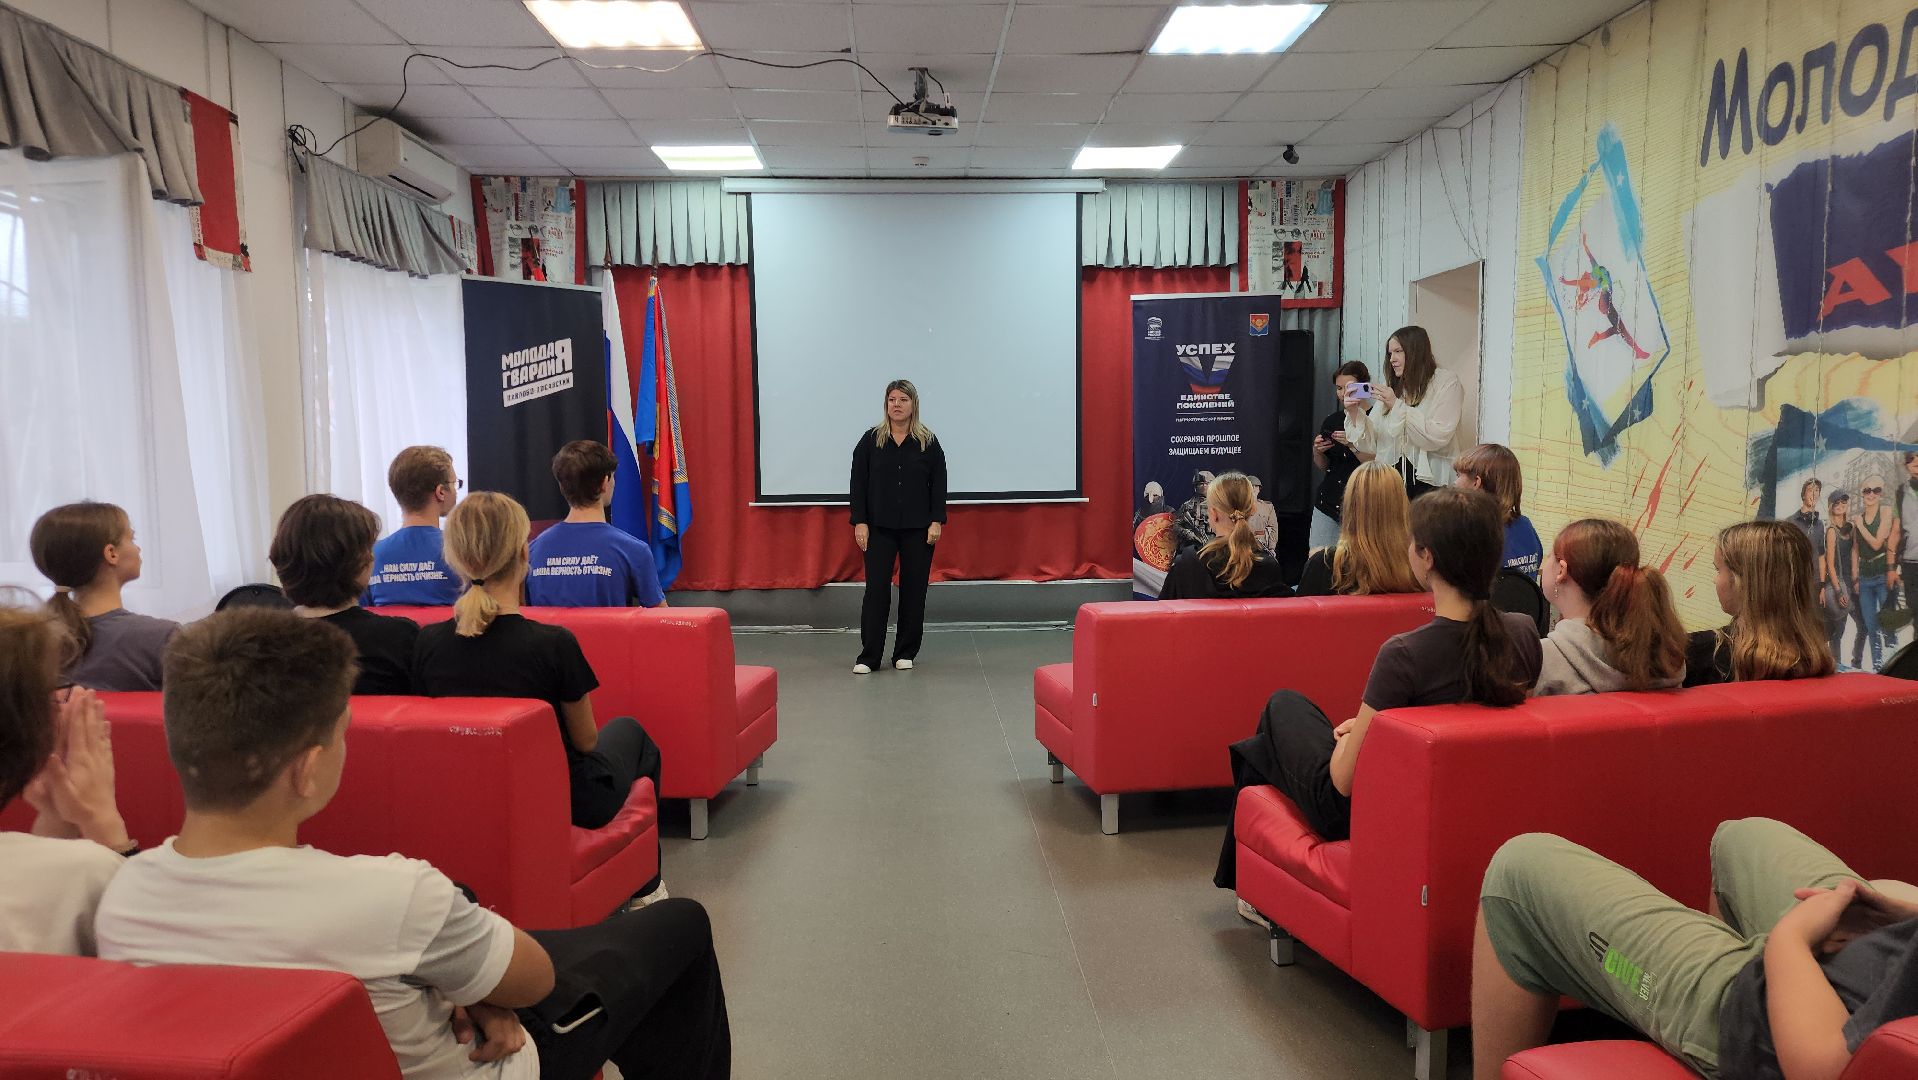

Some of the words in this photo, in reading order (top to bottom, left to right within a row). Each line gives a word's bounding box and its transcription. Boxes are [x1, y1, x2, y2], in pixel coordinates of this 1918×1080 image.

[1176, 343, 1235, 355] УСПЕХ
[1180, 393, 1231, 401] ЕДИНСТВЕ
[1176, 400, 1235, 409] ПОКОЛЕНИЙ
[1170, 435, 1205, 444] СОХРАНЯЯ
[1206, 434, 1240, 443] ПРОШЛОЕ
[1168, 447, 1209, 456] ЗАЩИЩАЕМ
[1210, 446, 1242, 455] БУДУЩЕЕ
